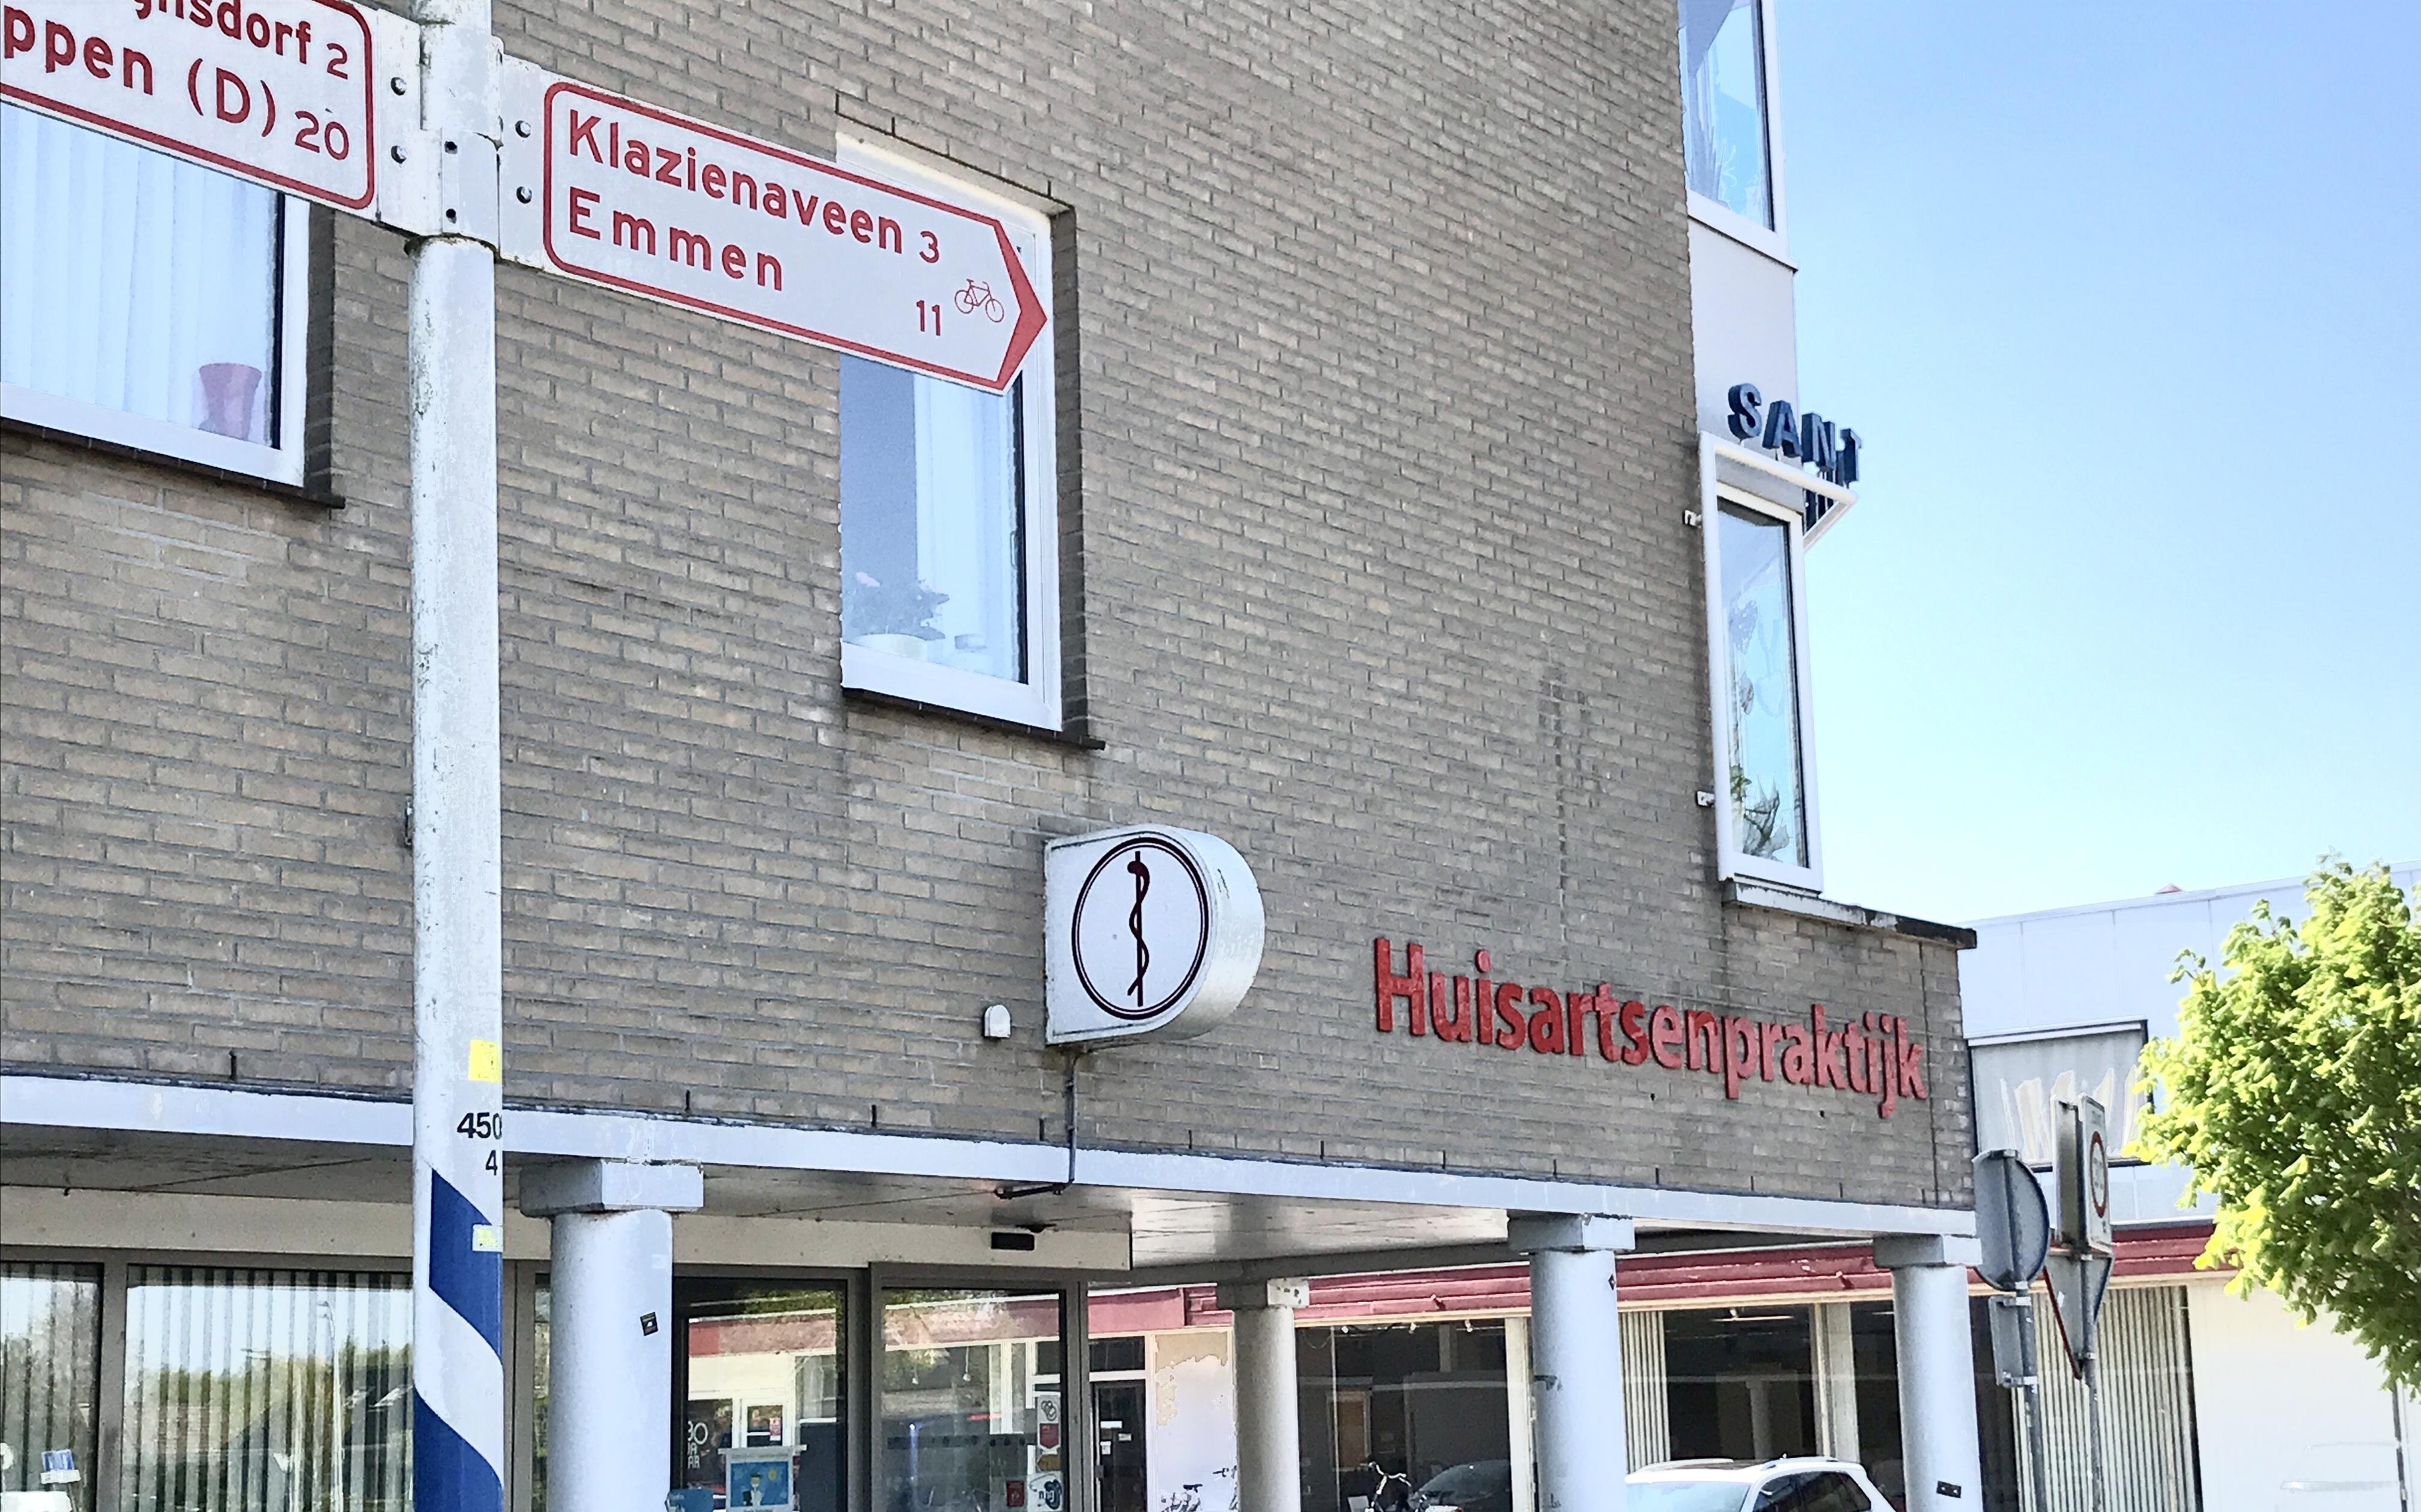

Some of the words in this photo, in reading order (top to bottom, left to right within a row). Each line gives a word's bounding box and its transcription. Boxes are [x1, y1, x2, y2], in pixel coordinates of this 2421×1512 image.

[4, 7, 153, 95] ppen
[187, 58, 276, 138] (D)
[295, 110, 350, 160] 20
[327, 43, 348, 80] 2
[569, 109, 902, 255] Klazienaveen
[920, 231, 940, 264] 3
[569, 187, 782, 291] Emmen
[916, 300, 941, 337] 11
[1374, 937, 1927, 1118] Huisartsenpraktijk
[485, 1149, 498, 1176] 4
